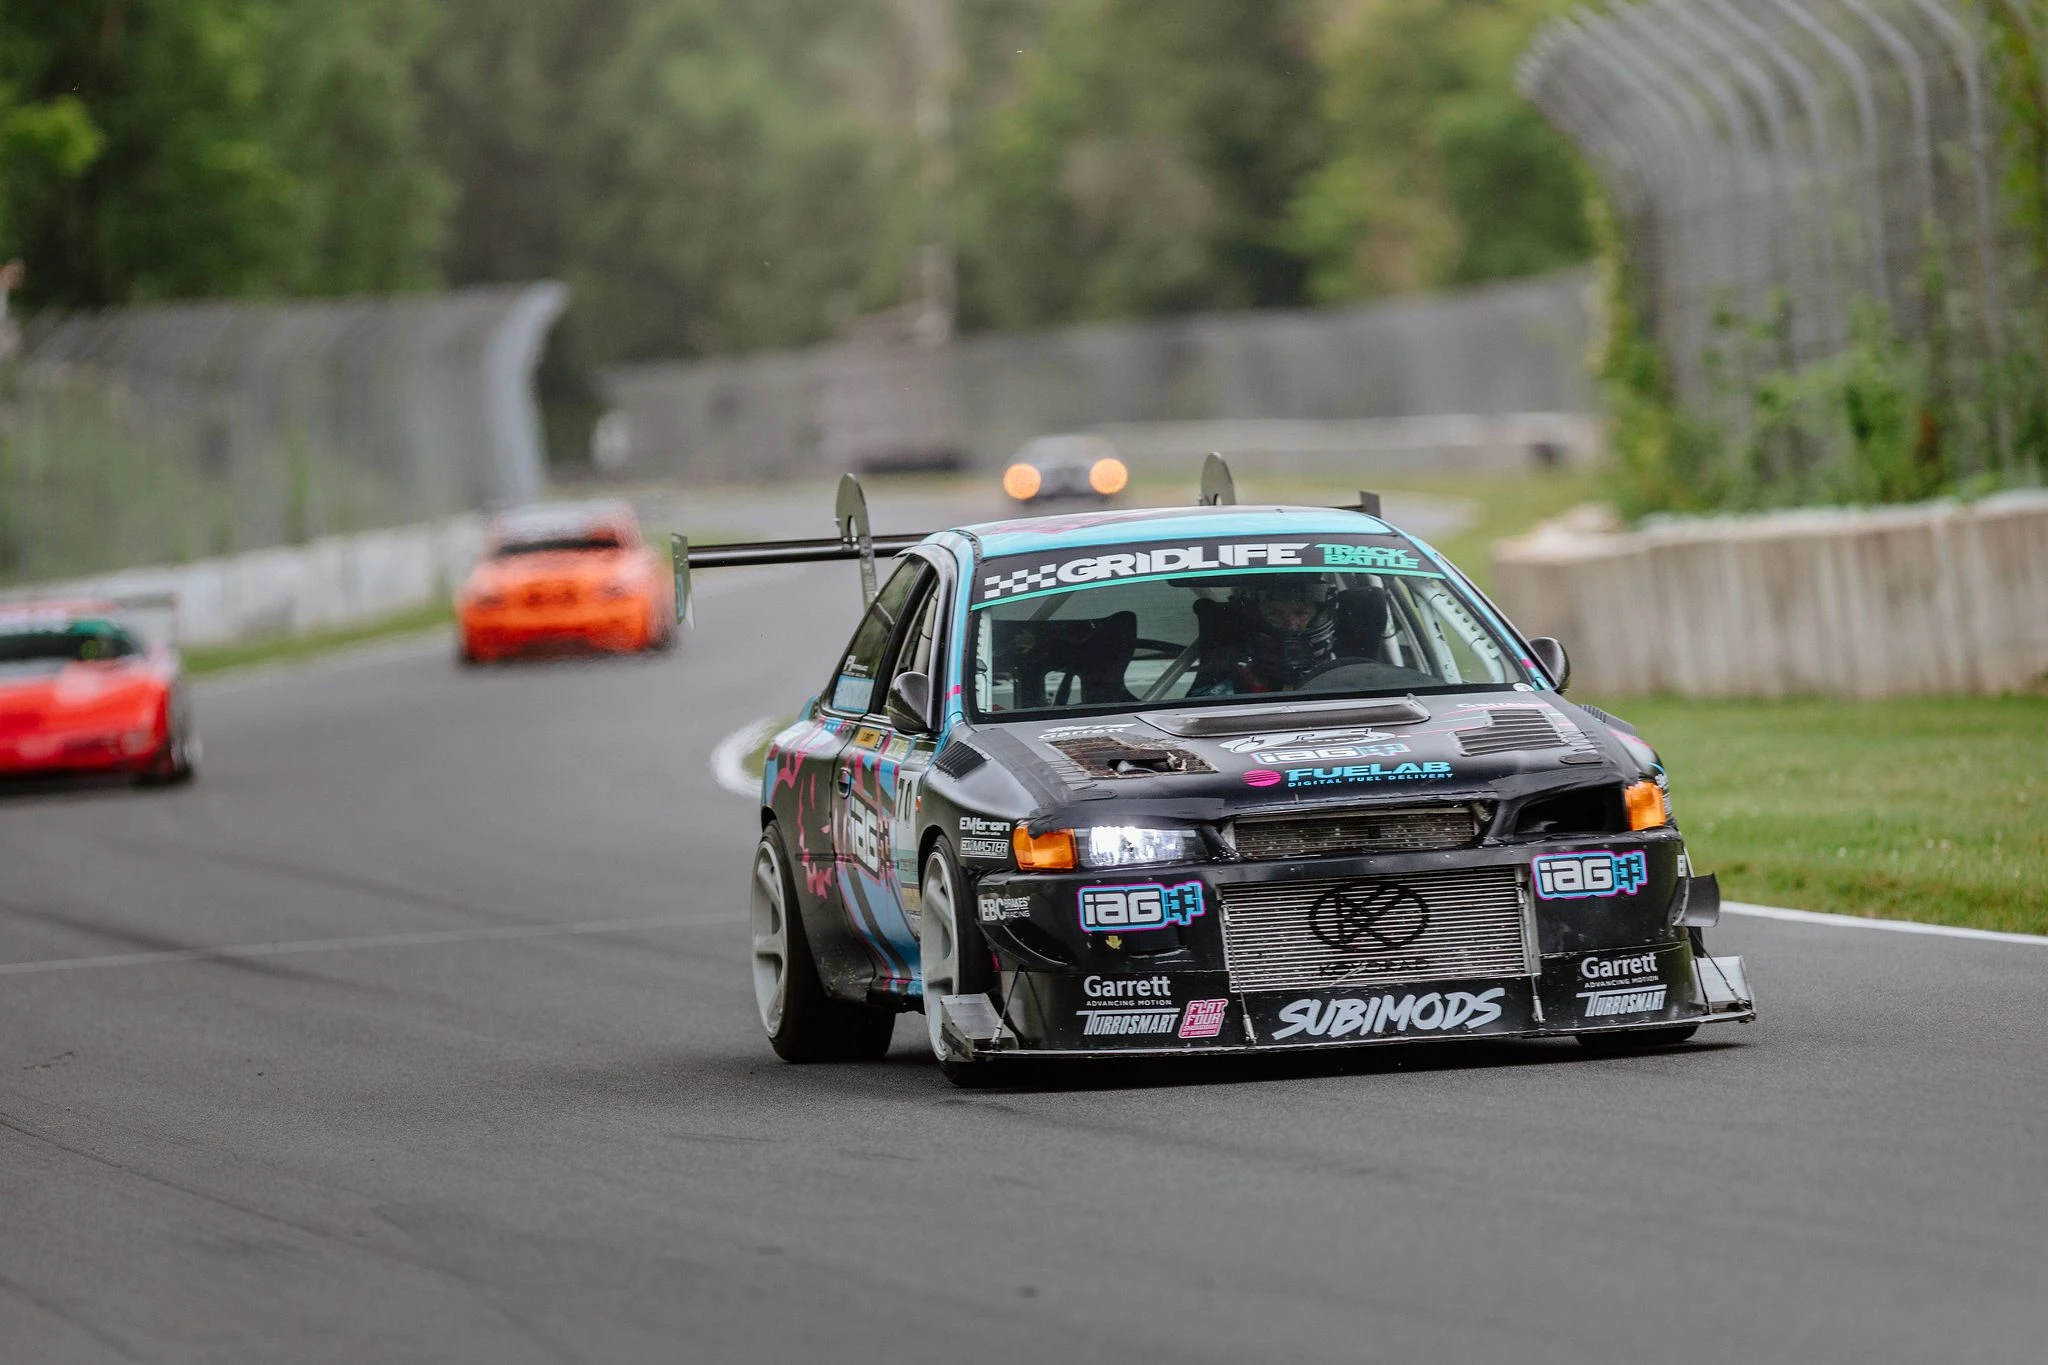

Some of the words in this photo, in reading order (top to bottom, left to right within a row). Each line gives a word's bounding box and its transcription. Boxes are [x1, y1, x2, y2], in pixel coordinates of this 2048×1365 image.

[1315, 544, 1408, 557] TRACK
[1057, 543, 1309, 582] GRIDLIFE
[1323, 555, 1420, 569] BATTLE
[1286, 762, 1451, 781] FUELAB
[1288, 778, 1342, 788] DIGITAL
[1389, 773, 1454, 782] DELIVERY
[981, 897, 1006, 921] EBC
[1581, 952, 1658, 979] Garrett
[1083, 975, 1171, 997] Garrett
[1584, 978, 1630, 988] ADVANCING
[1631, 975, 1659, 984] MOTION
[1189, 1002, 1225, 1014] FLAT
[1576, 984, 1667, 1017] TURBOSMART
[1075, 1008, 1180, 1035] TURBOSMART
[1186, 1013, 1222, 1026] FOUR
[1271, 988, 1506, 1040] SUBIMODS
